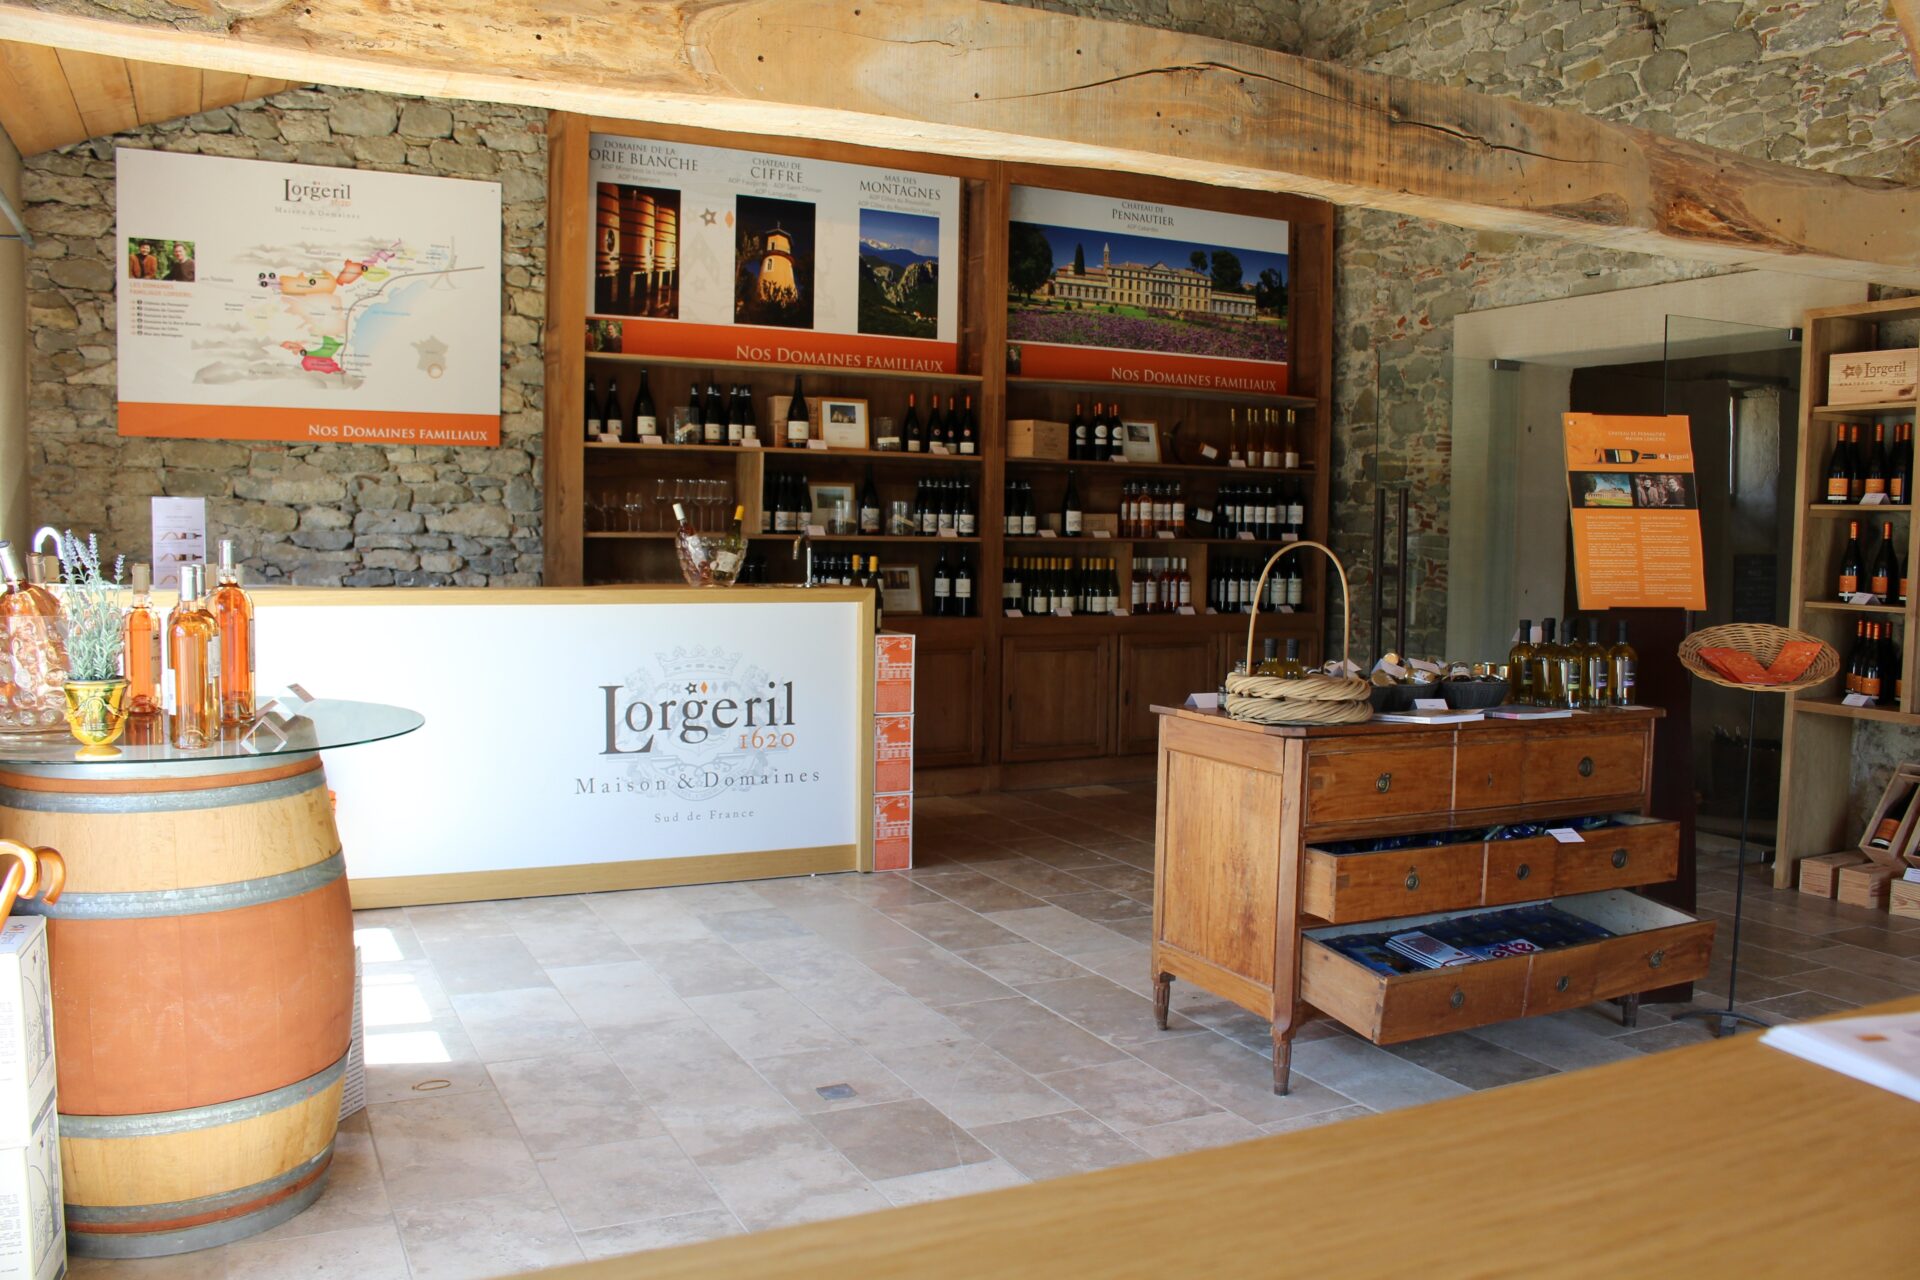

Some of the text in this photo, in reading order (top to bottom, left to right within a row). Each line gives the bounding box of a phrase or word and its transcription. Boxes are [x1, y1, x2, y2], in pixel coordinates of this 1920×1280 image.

[603, 140, 676, 155] DOMAINE DE LA
[630, 152, 699, 172] BLANCHE
[791, 161, 801, 170] DE
[750, 166, 804, 183] CIFFRE
[884, 175, 917, 185] MAS DES
[283, 179, 351, 202] Lorgeril
[860, 180, 941, 200] MONTAGNES
[1112, 208, 1175, 226] PENNAUTIER
[736, 345, 944, 372] NOS DOMAINES FAMILIAUX
[1864, 360, 1906, 378] Lorgeril
[1111, 367, 1277, 392] NOS DOMAINES FAMILIAUX
[308, 424, 488, 441] NOS DOMAINES FAMILIAUX
[598, 681, 796, 755] Lorgeril
[739, 727, 795, 750] 1620
[575, 769, 821, 795] Maison & Domaines
[654, 809, 755, 824] Sud de France
